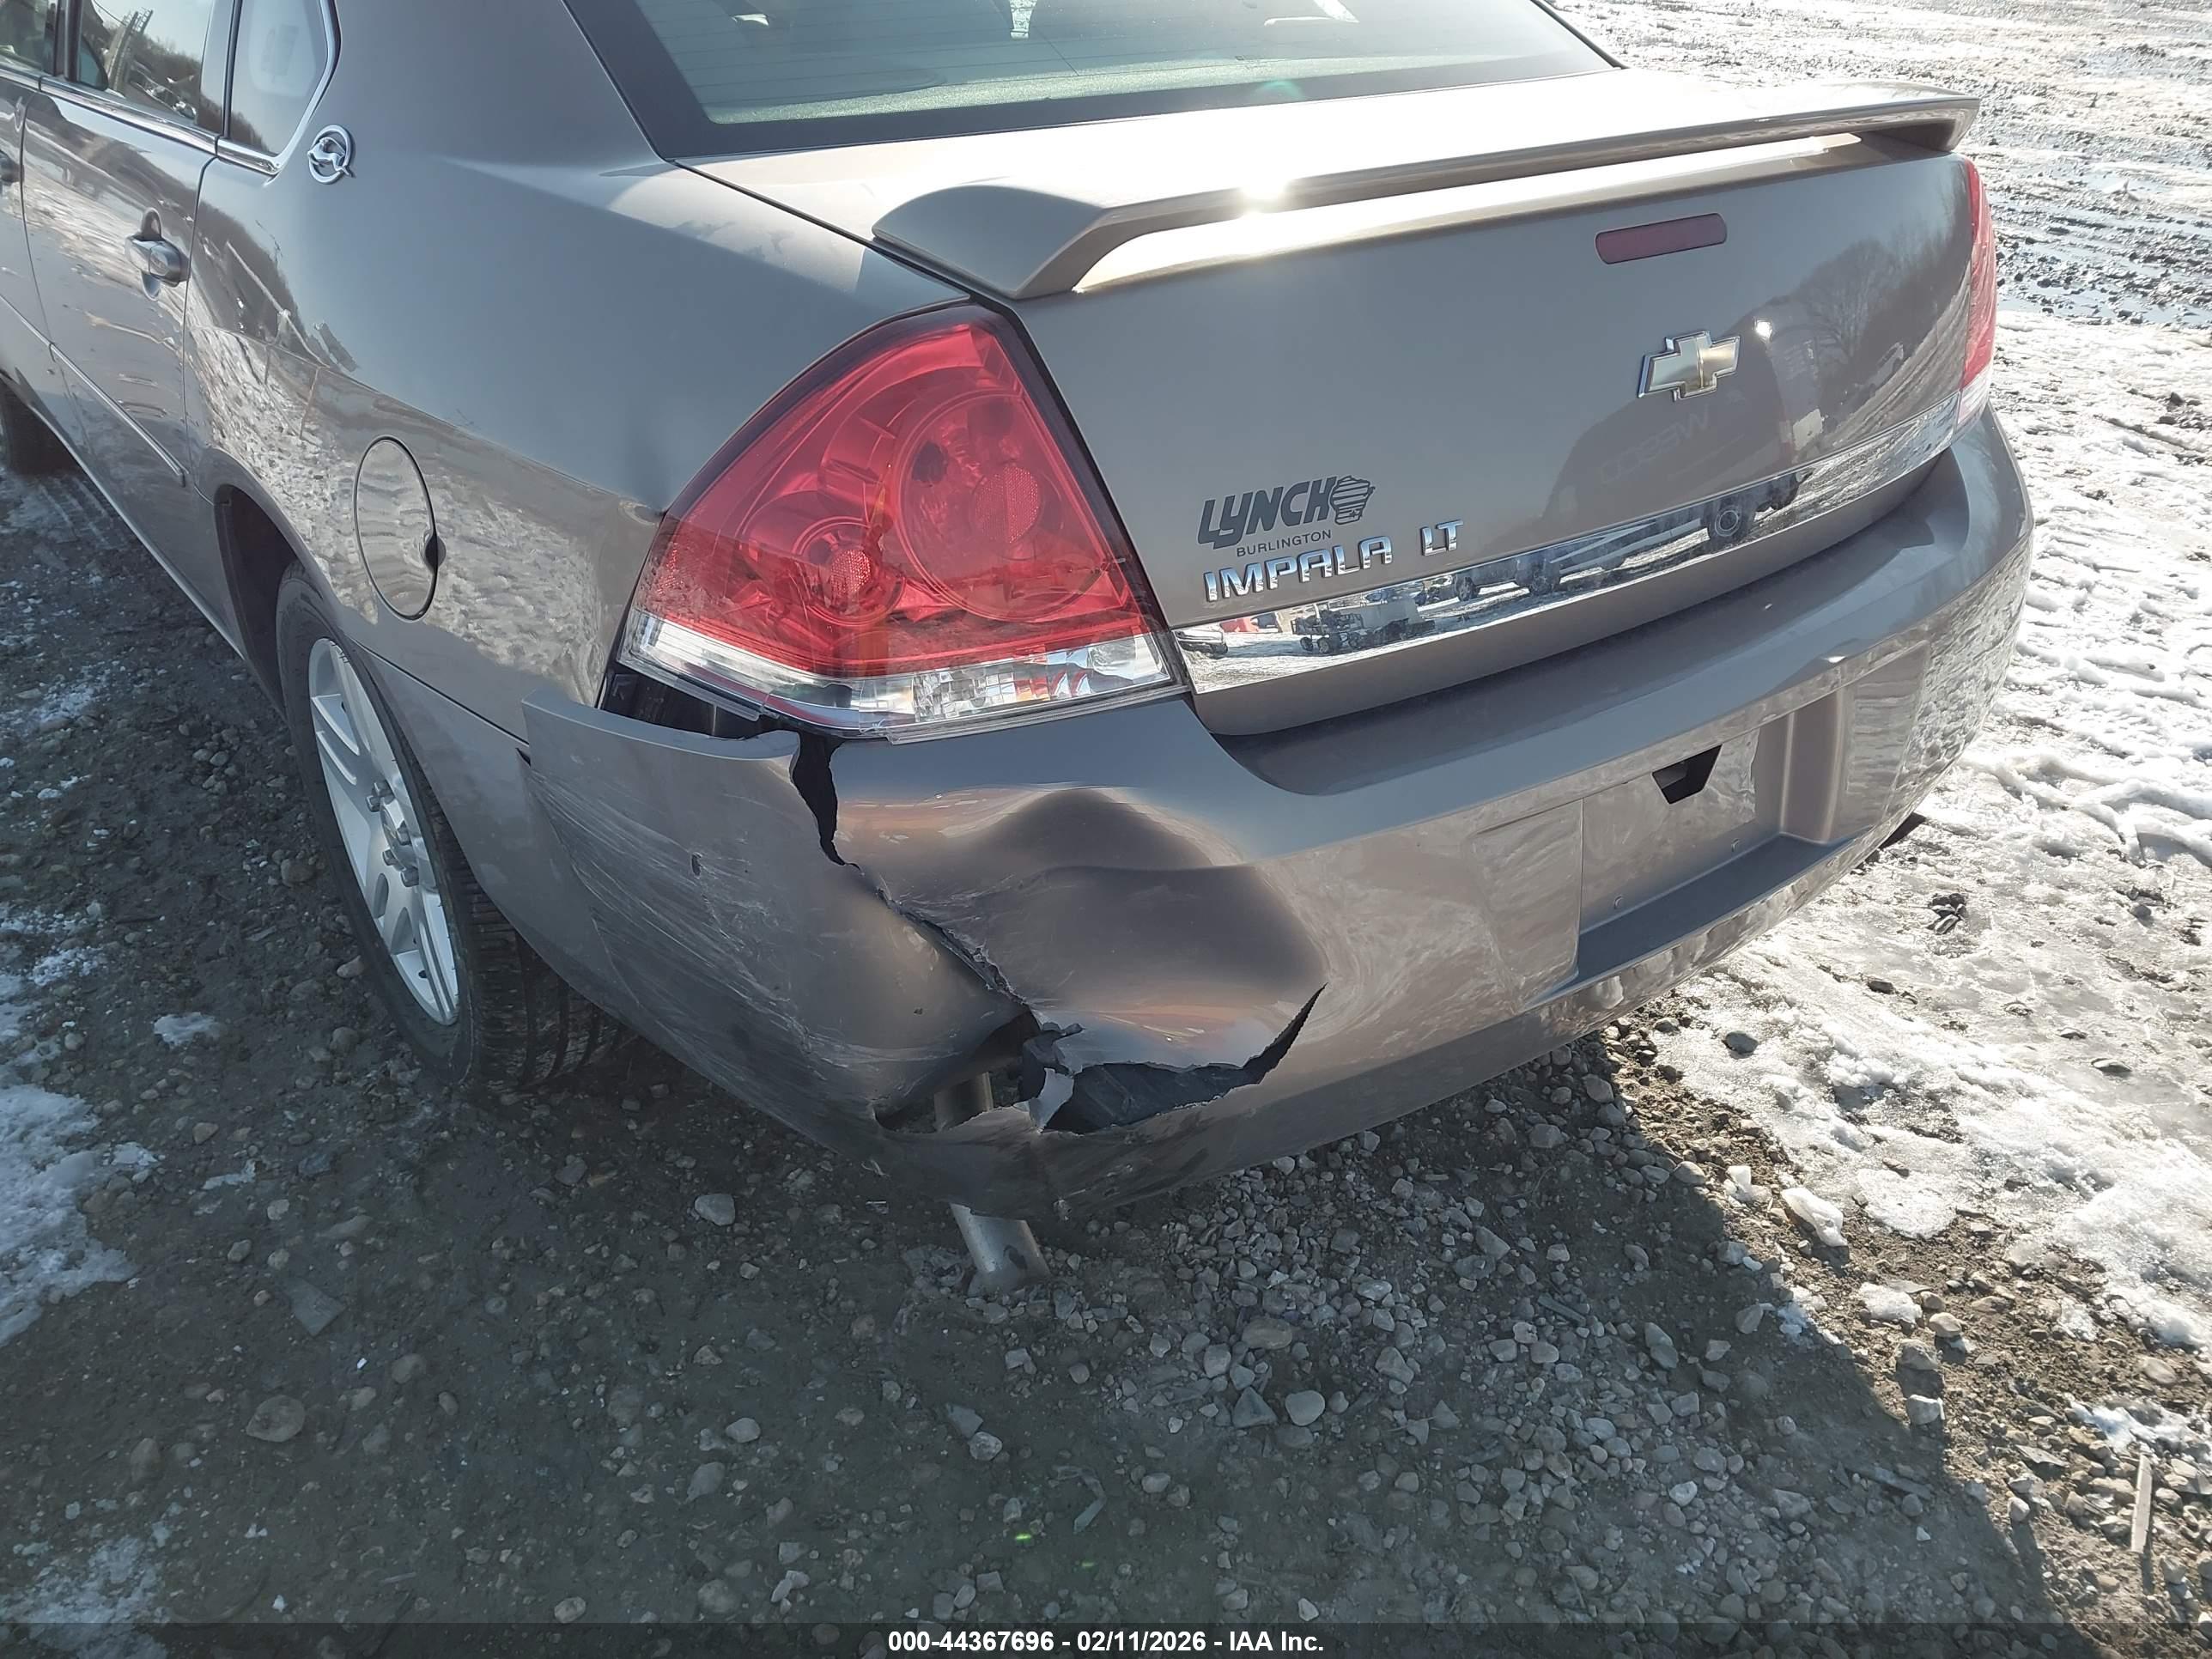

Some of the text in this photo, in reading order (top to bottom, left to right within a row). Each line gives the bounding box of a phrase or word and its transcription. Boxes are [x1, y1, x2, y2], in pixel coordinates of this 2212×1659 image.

[1198, 476, 1335, 549] LYNCH
[1237, 530, 1332, 557] BURLINGTON
[1204, 520, 1463, 601] IMPALA LT
